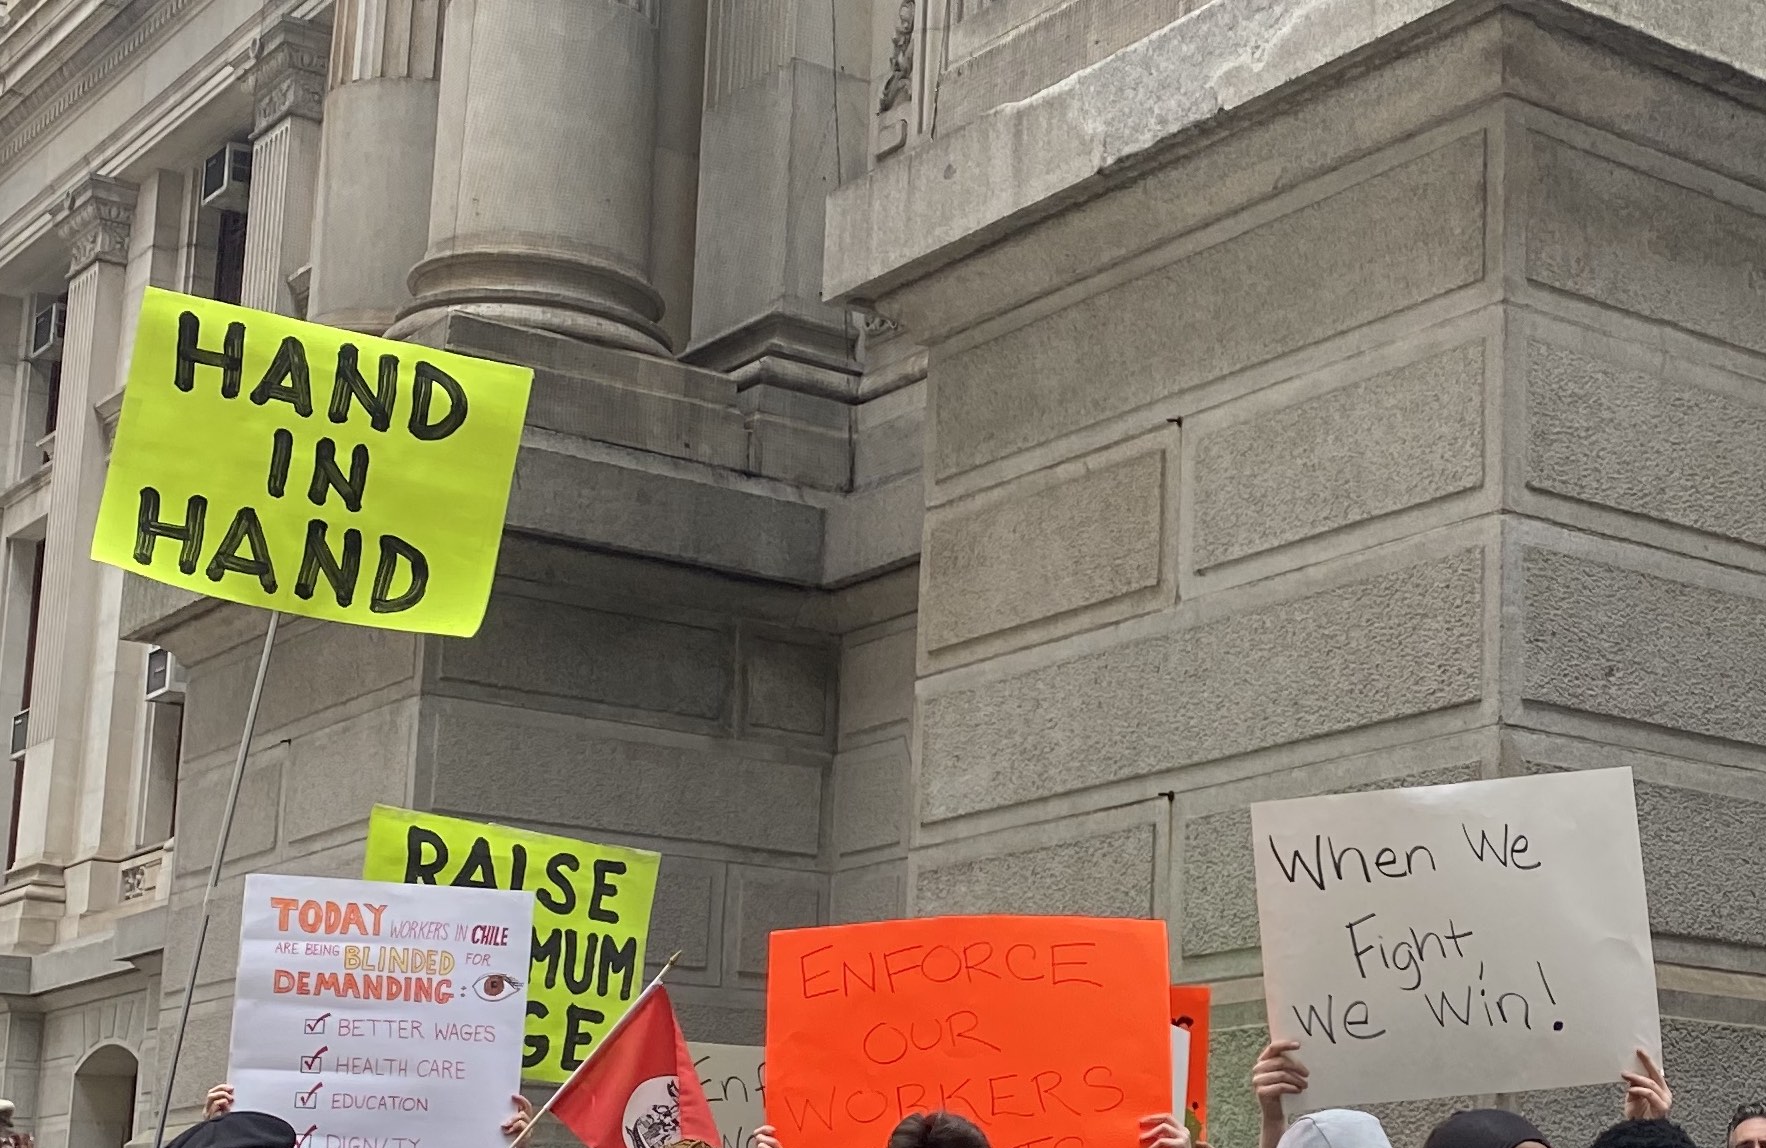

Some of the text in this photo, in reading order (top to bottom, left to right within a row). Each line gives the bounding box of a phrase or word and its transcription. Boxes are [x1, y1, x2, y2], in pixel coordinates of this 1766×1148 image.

[174, 311, 469, 441] HAND
[267, 428, 370, 512] IN
[133, 486, 428, 612] HAND
[404, 825, 628, 924] RAISE
[1269, 823, 1541, 891] When We
[270, 897, 509, 946] TODAY WORKERS IN CHILE
[275, 941, 491, 975] ARE BEING BLINDED FOR
[800, 941, 1103, 999] ENFORCE
[338, 1018, 496, 1042] BETTER WAGES
[1292, 960, 1564, 1044] We Win!
[335, 1057, 467, 1079] HEALTH CARE
[863, 1010, 1001, 1064] OUR
[331, 1093, 428, 1112] EDUCATION
[783, 1065, 1125, 1132] WORKERS
